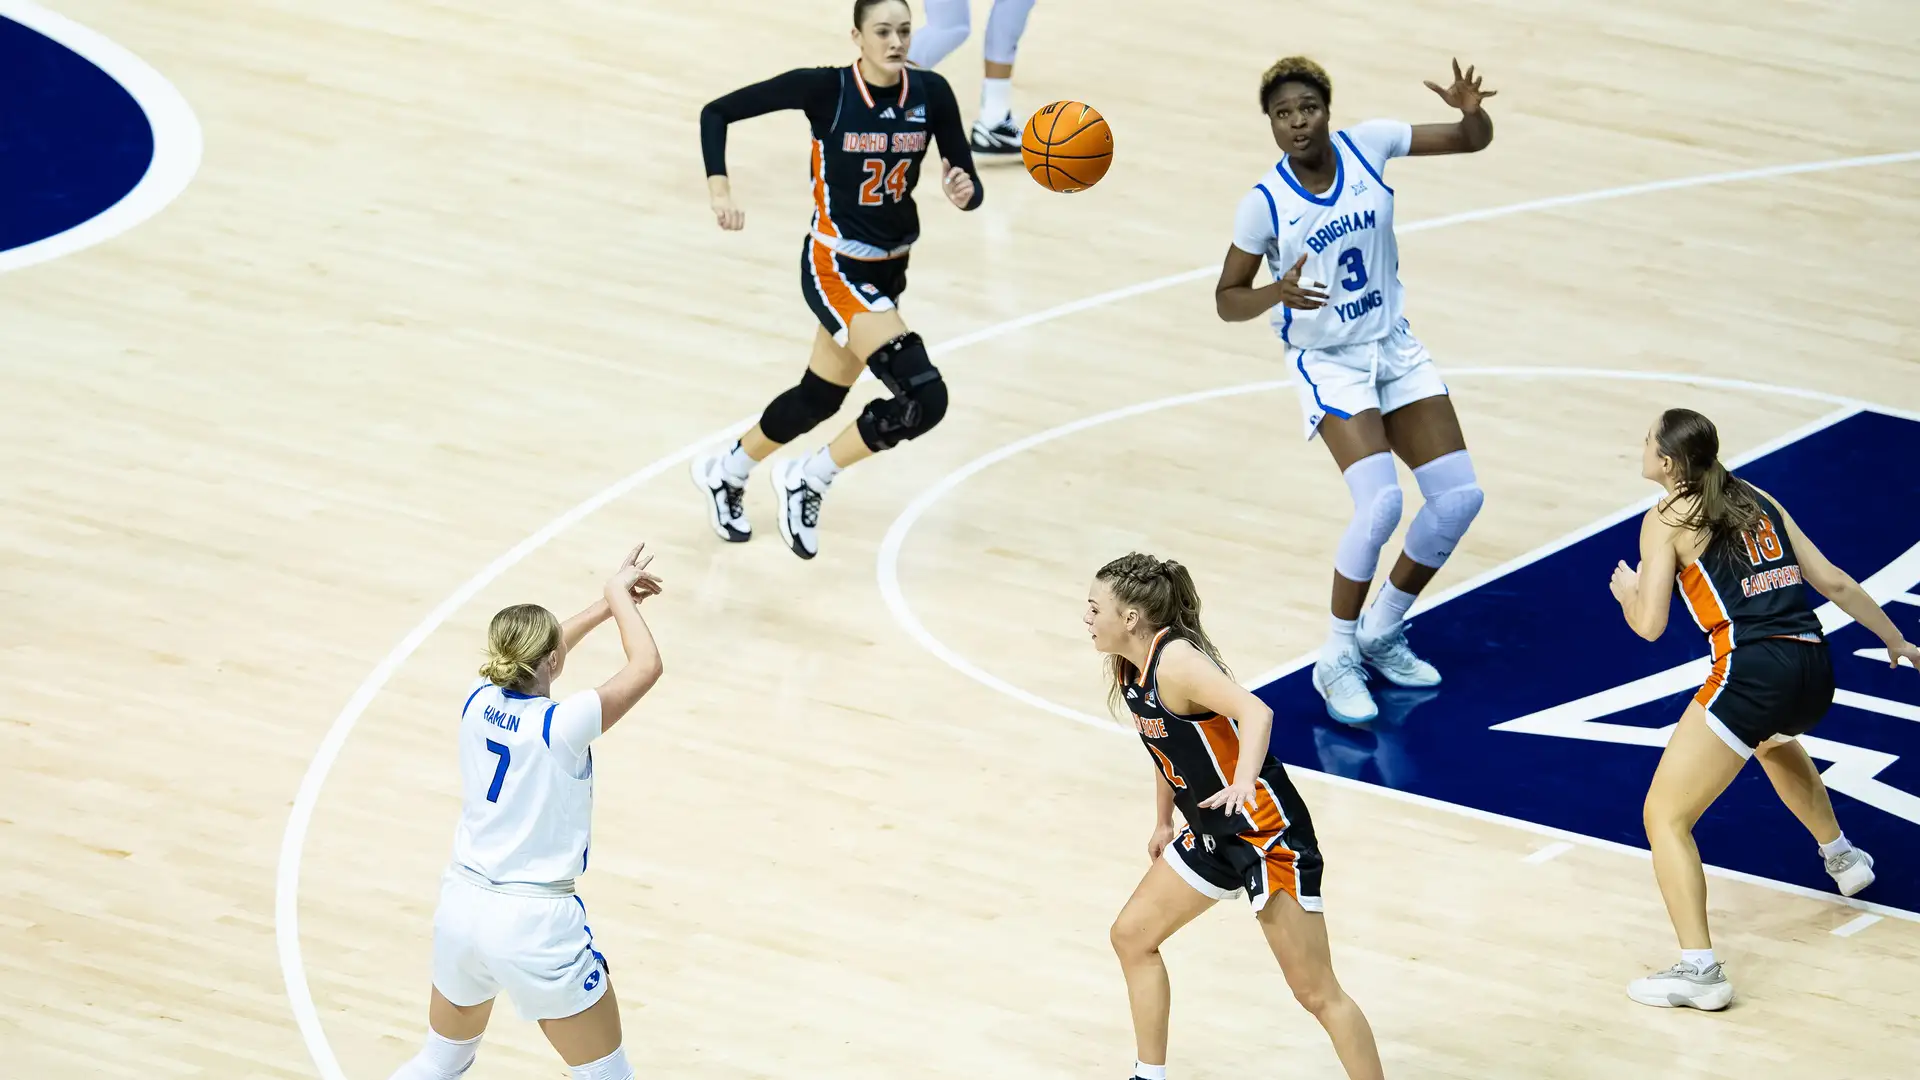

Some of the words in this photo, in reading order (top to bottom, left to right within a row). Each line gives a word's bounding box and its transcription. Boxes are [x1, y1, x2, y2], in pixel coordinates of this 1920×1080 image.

[842, 132, 888, 153] IDAHO
[859, 159, 912, 206] 24
[1306, 210, 1376, 254] BRIGHAM
[1338, 247, 1368, 292] 3
[1334, 290, 1383, 323] YOUNG
[484, 704, 520, 732] HAMLIN
[486, 737, 511, 804] 7
